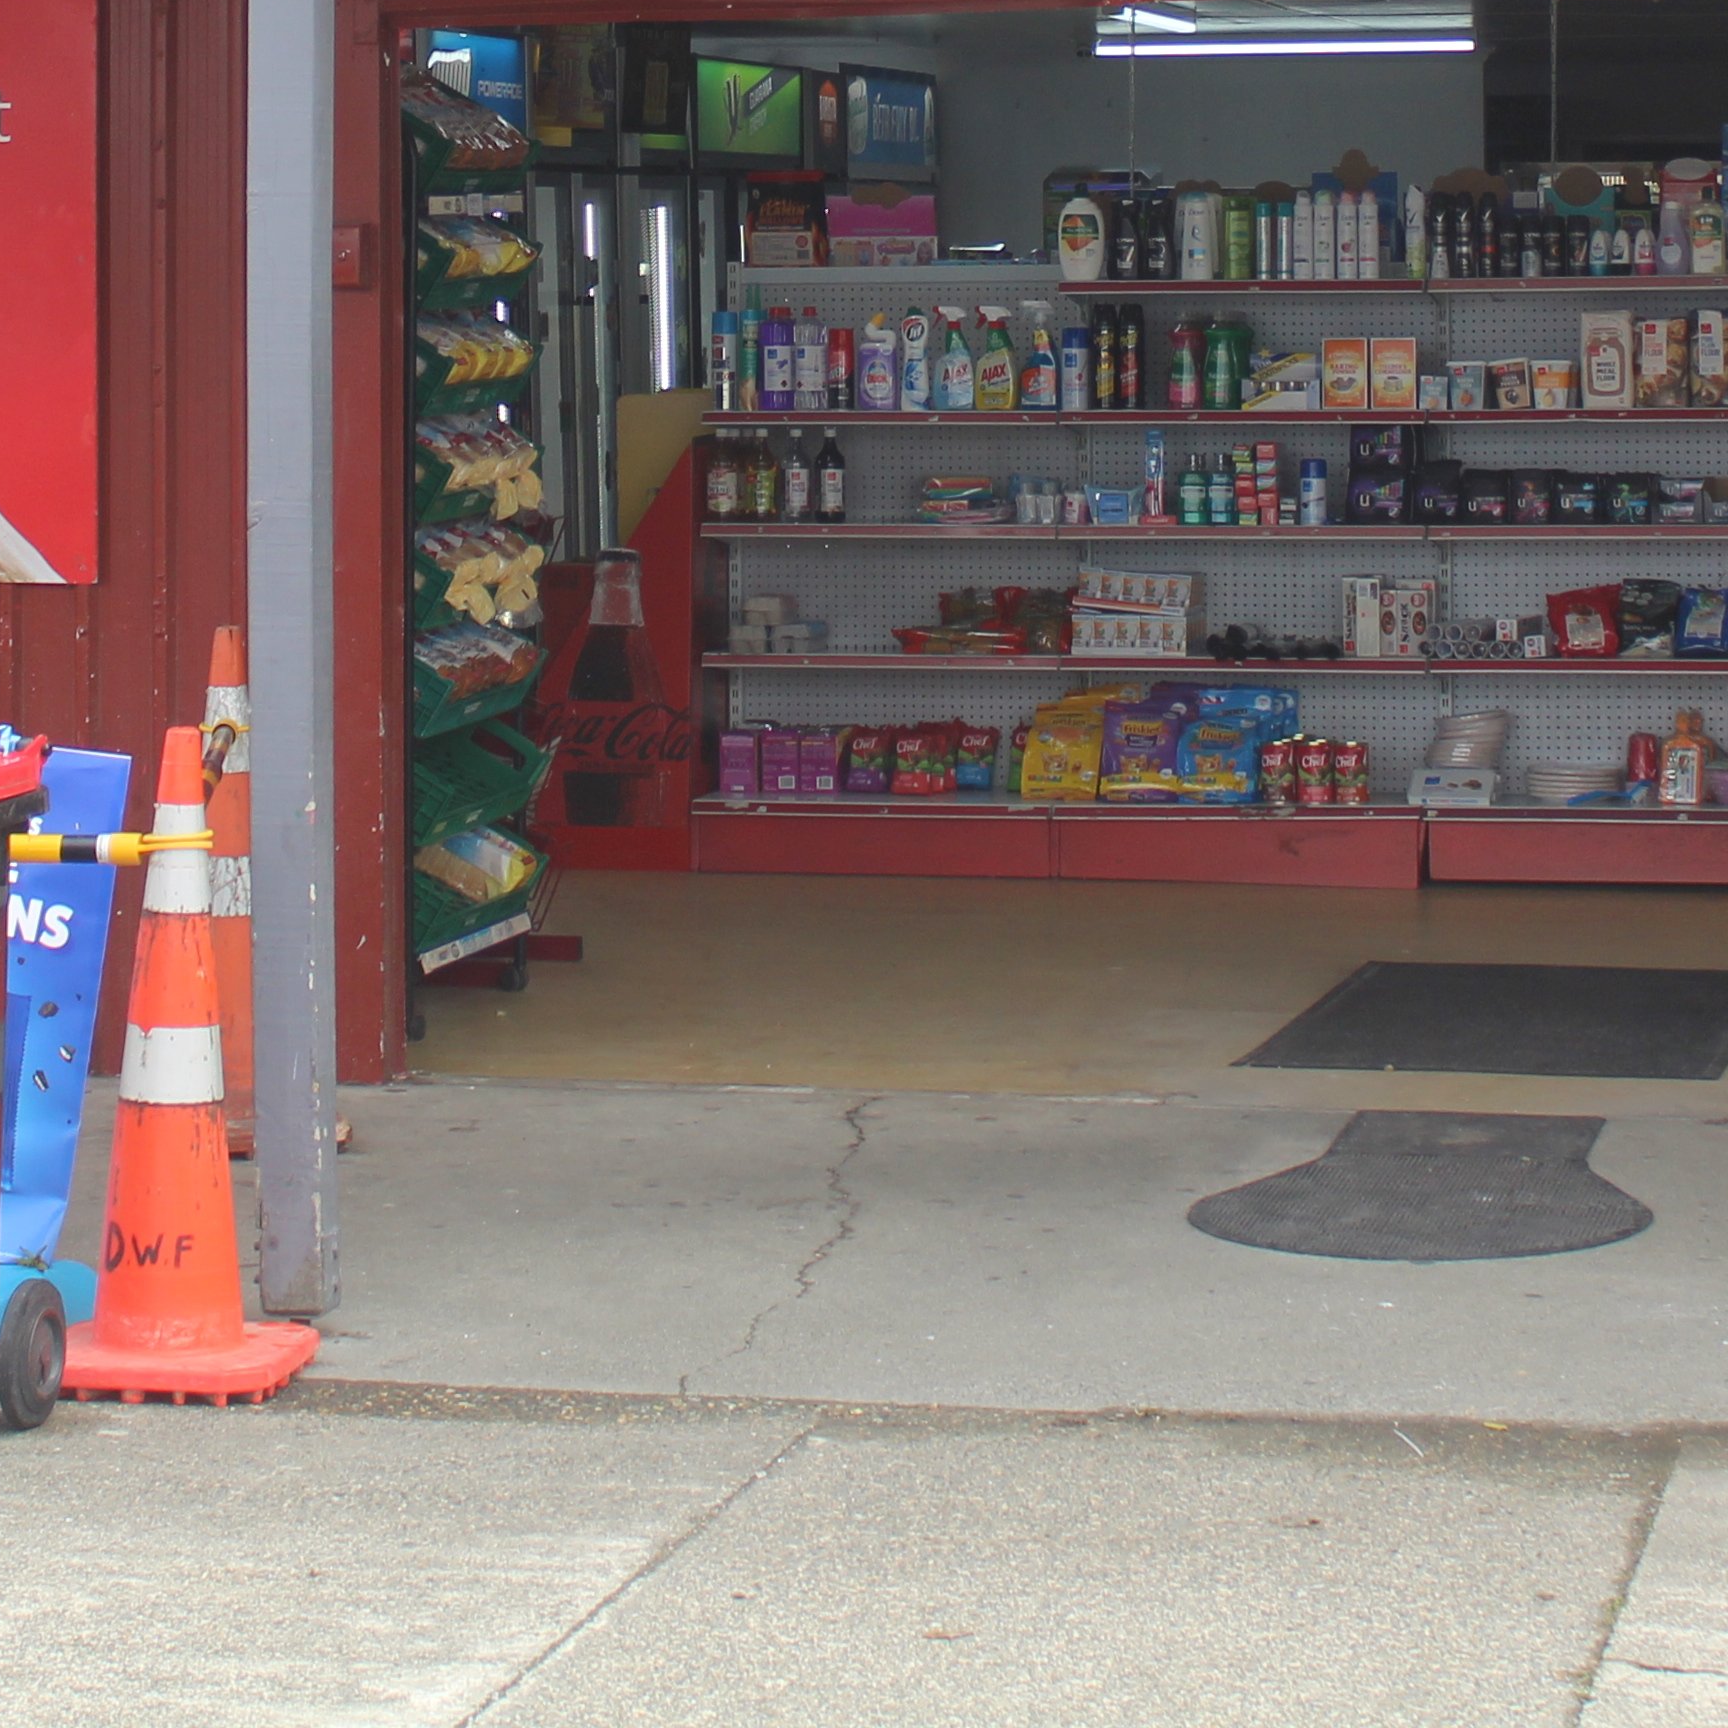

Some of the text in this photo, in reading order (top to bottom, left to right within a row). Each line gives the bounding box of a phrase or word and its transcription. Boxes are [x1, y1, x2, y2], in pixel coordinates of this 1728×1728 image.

[943, 364, 968, 382] AJAX
[981, 363, 1006, 382] AJAX
[853, 737, 878, 751] Chef
[896, 739, 922, 753] Chef
[962, 734, 990, 747] Chef
[1302, 755, 1326, 768] Chef
